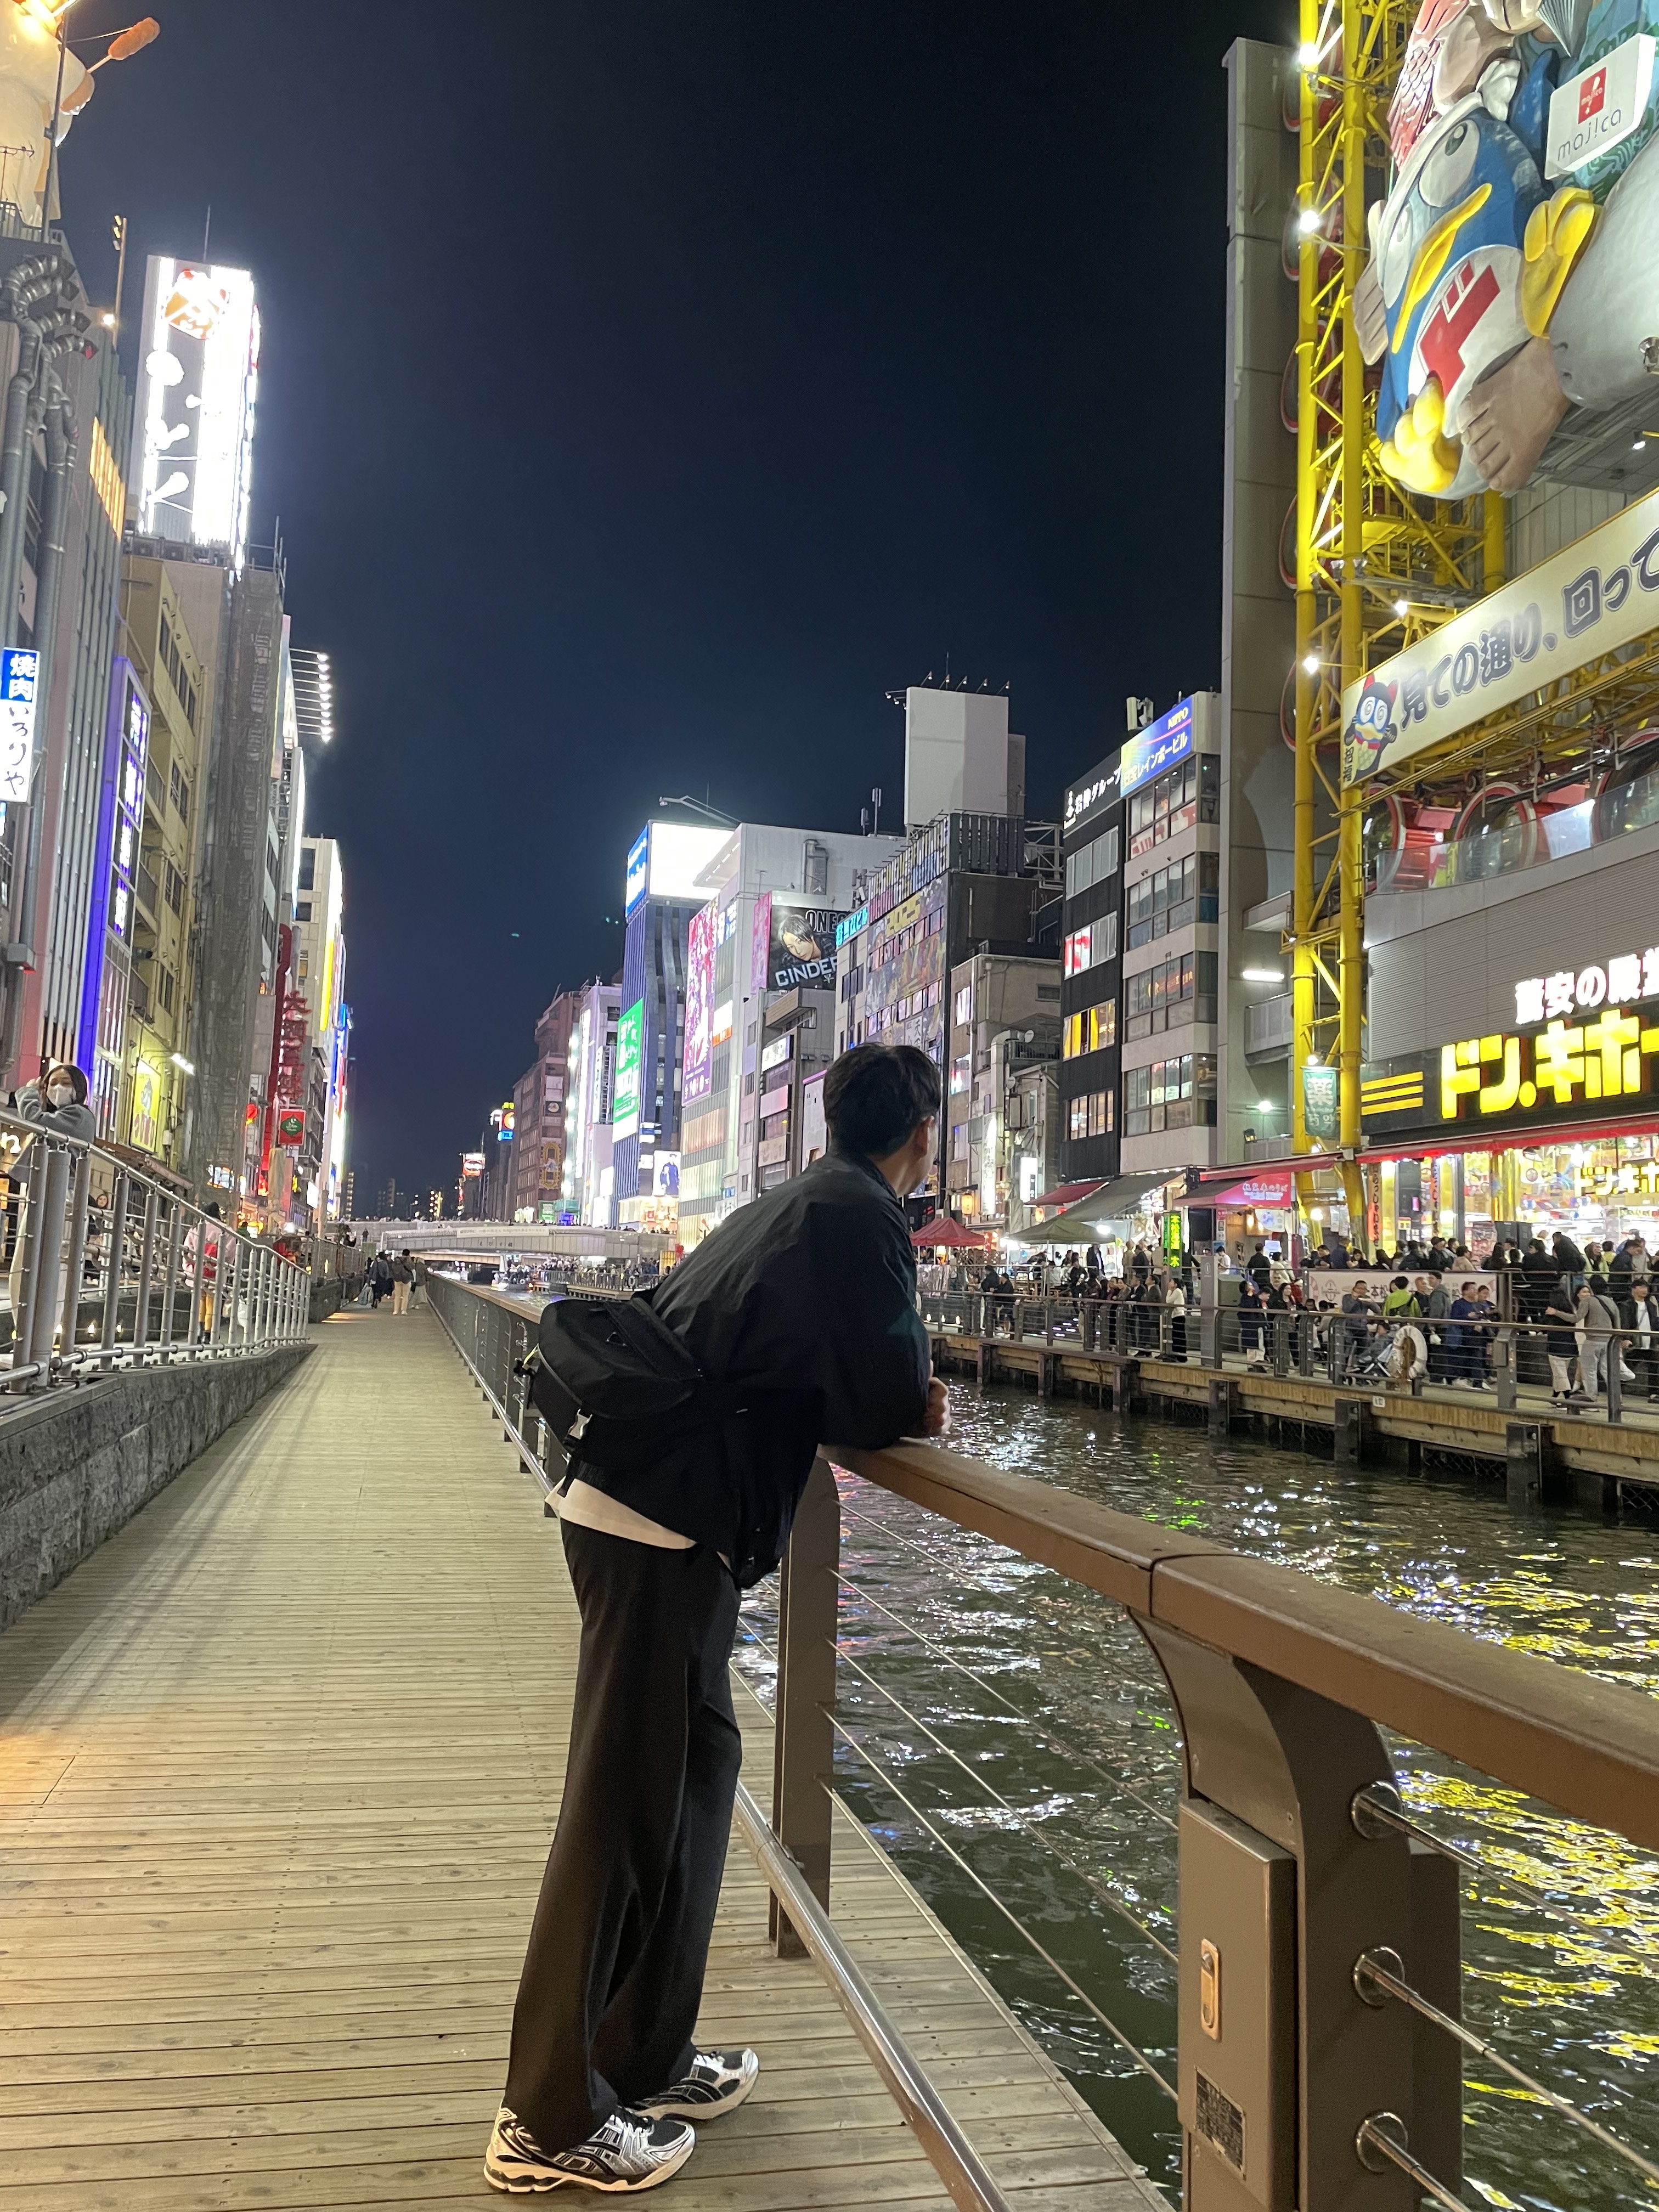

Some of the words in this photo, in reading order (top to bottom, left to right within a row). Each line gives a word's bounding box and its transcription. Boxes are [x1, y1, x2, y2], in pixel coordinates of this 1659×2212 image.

[9, 653, 35, 701] 焼肉
[4, 707, 29, 795] いろりや
